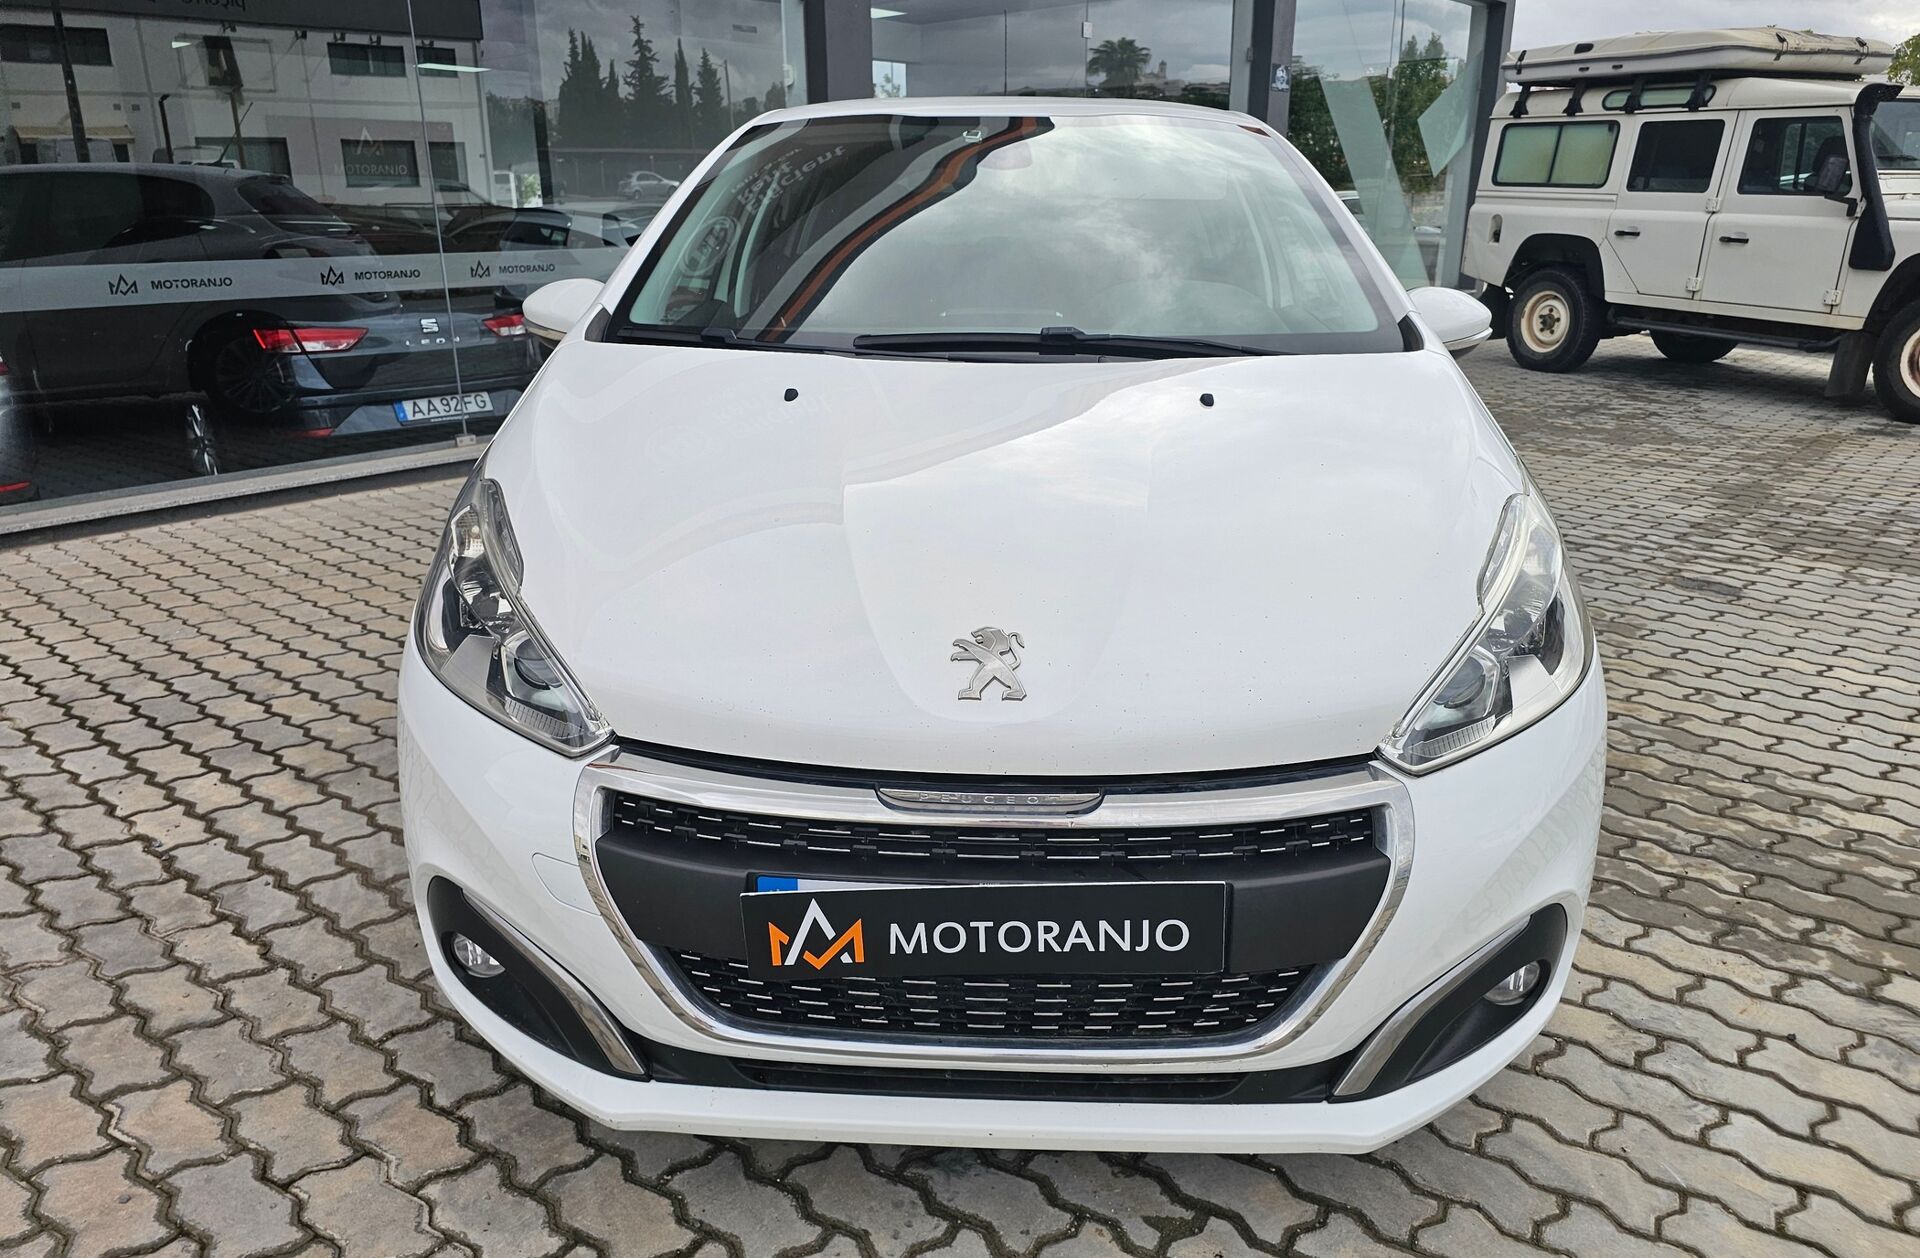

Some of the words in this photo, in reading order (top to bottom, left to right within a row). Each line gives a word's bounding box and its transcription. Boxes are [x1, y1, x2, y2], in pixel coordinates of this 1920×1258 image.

[354, 268, 421, 282] MOTORANJO
[499, 263, 556, 275] MOTORANJO
[150, 276, 233, 291] MOTORANJO
[918, 792, 1061, 805] PEUGEOT
[889, 919, 1191, 955] MOTORANJO
